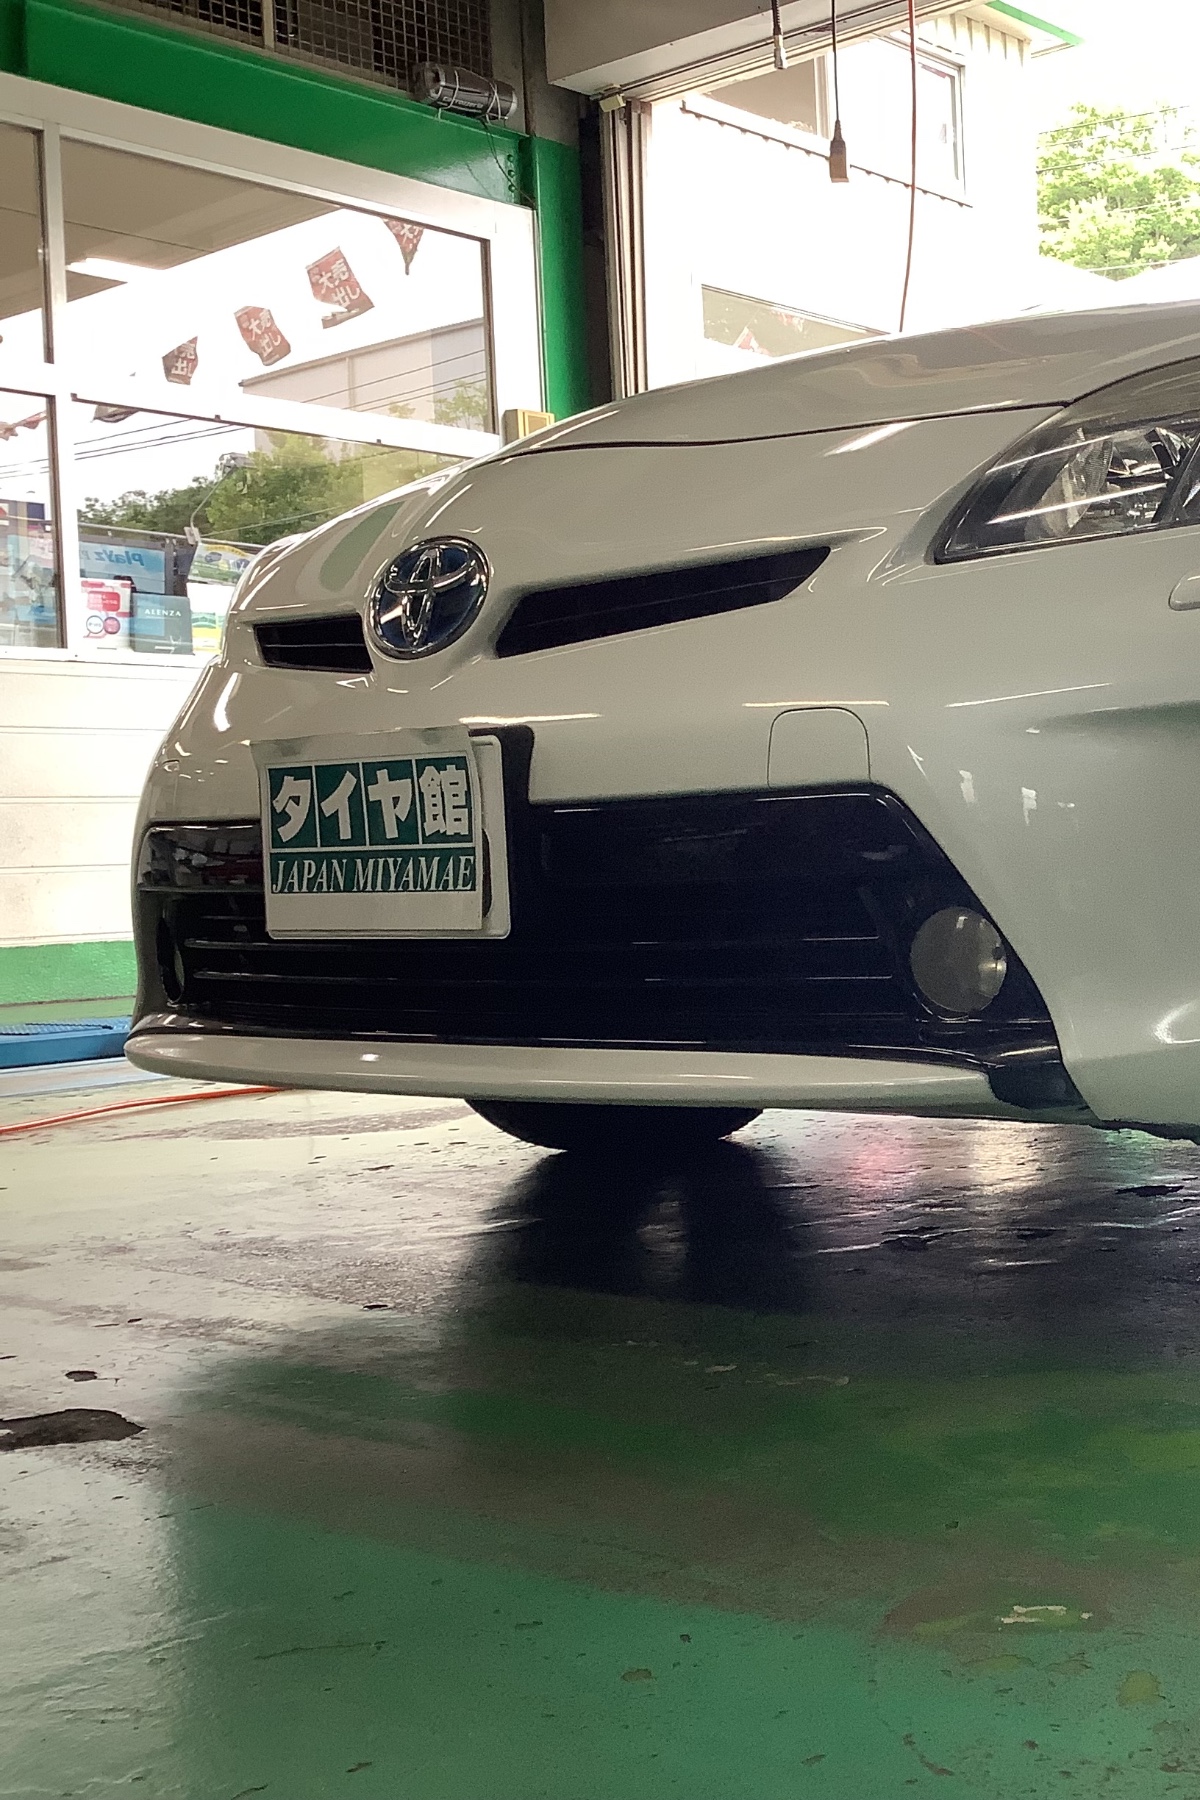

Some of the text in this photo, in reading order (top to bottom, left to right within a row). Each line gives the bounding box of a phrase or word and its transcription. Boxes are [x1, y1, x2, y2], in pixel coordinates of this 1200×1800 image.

[144, 608, 182, 617] ALENZA
[272, 764, 470, 843] タイヤ館
[272, 855, 474, 893] JAPAN MIYAMAE
